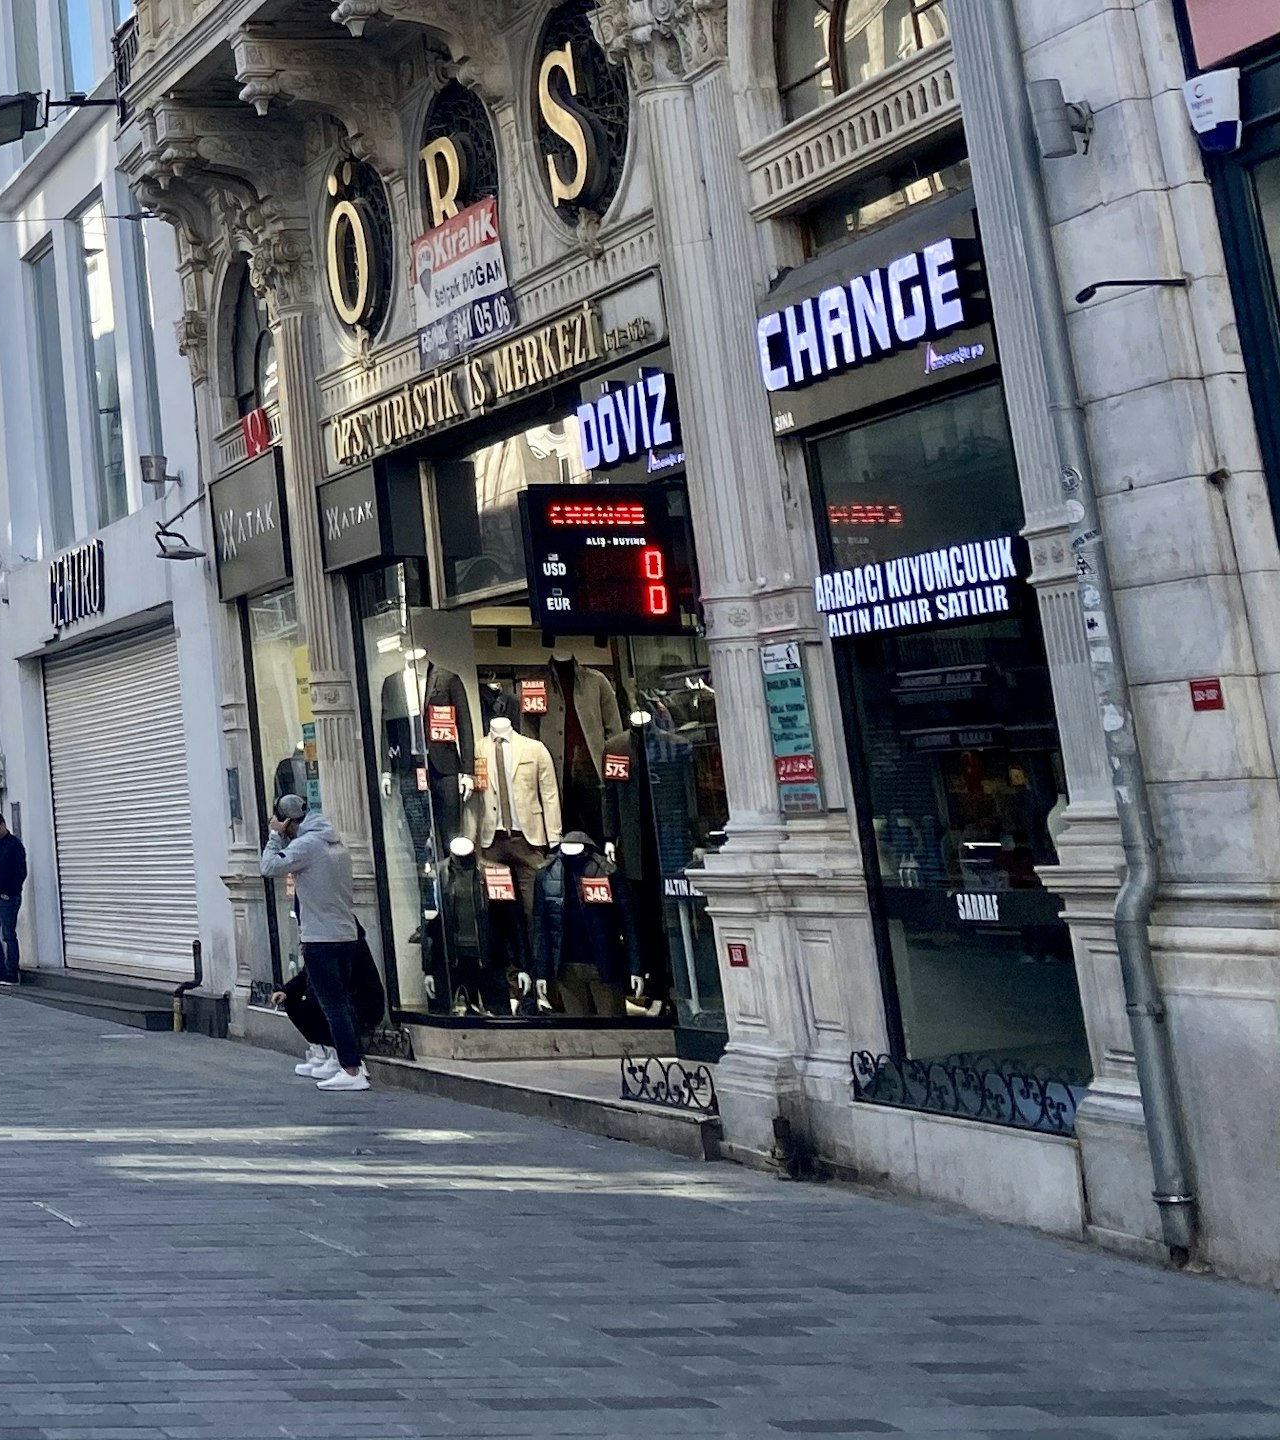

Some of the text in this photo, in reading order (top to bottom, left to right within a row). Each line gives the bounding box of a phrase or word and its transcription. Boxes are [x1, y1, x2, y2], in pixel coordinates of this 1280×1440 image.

[432, 208, 498, 269] Kiralık
[462, 258, 503, 294] DOĞAN
[474, 302, 493, 336] 05
[493, 295, 511, 329] 06
[758, 238, 964, 392] CHANGE
[364, 368, 460, 452] TURİSTİK
[463, 356, 487, 416] İŞ
[492, 300, 602, 399] MERKEZİ
[576, 367, 673, 472] DÖVİZ
[542, 550, 663, 580] USD 0
[814, 536, 1017, 612] ARABACI KUYUMCULUK
[546, 585, 668, 615] EUR 0
[828, 584, 1010, 638] ALTIN ALINIR SATILIR
[524, 696, 543, 711] 345
[430, 726, 451, 742] 675
[605, 762, 627, 778] 575
[586, 886, 609, 902] 345
[664, 878, 689, 897] ALTIN
[956, 893, 1000, 922] SARRAF
